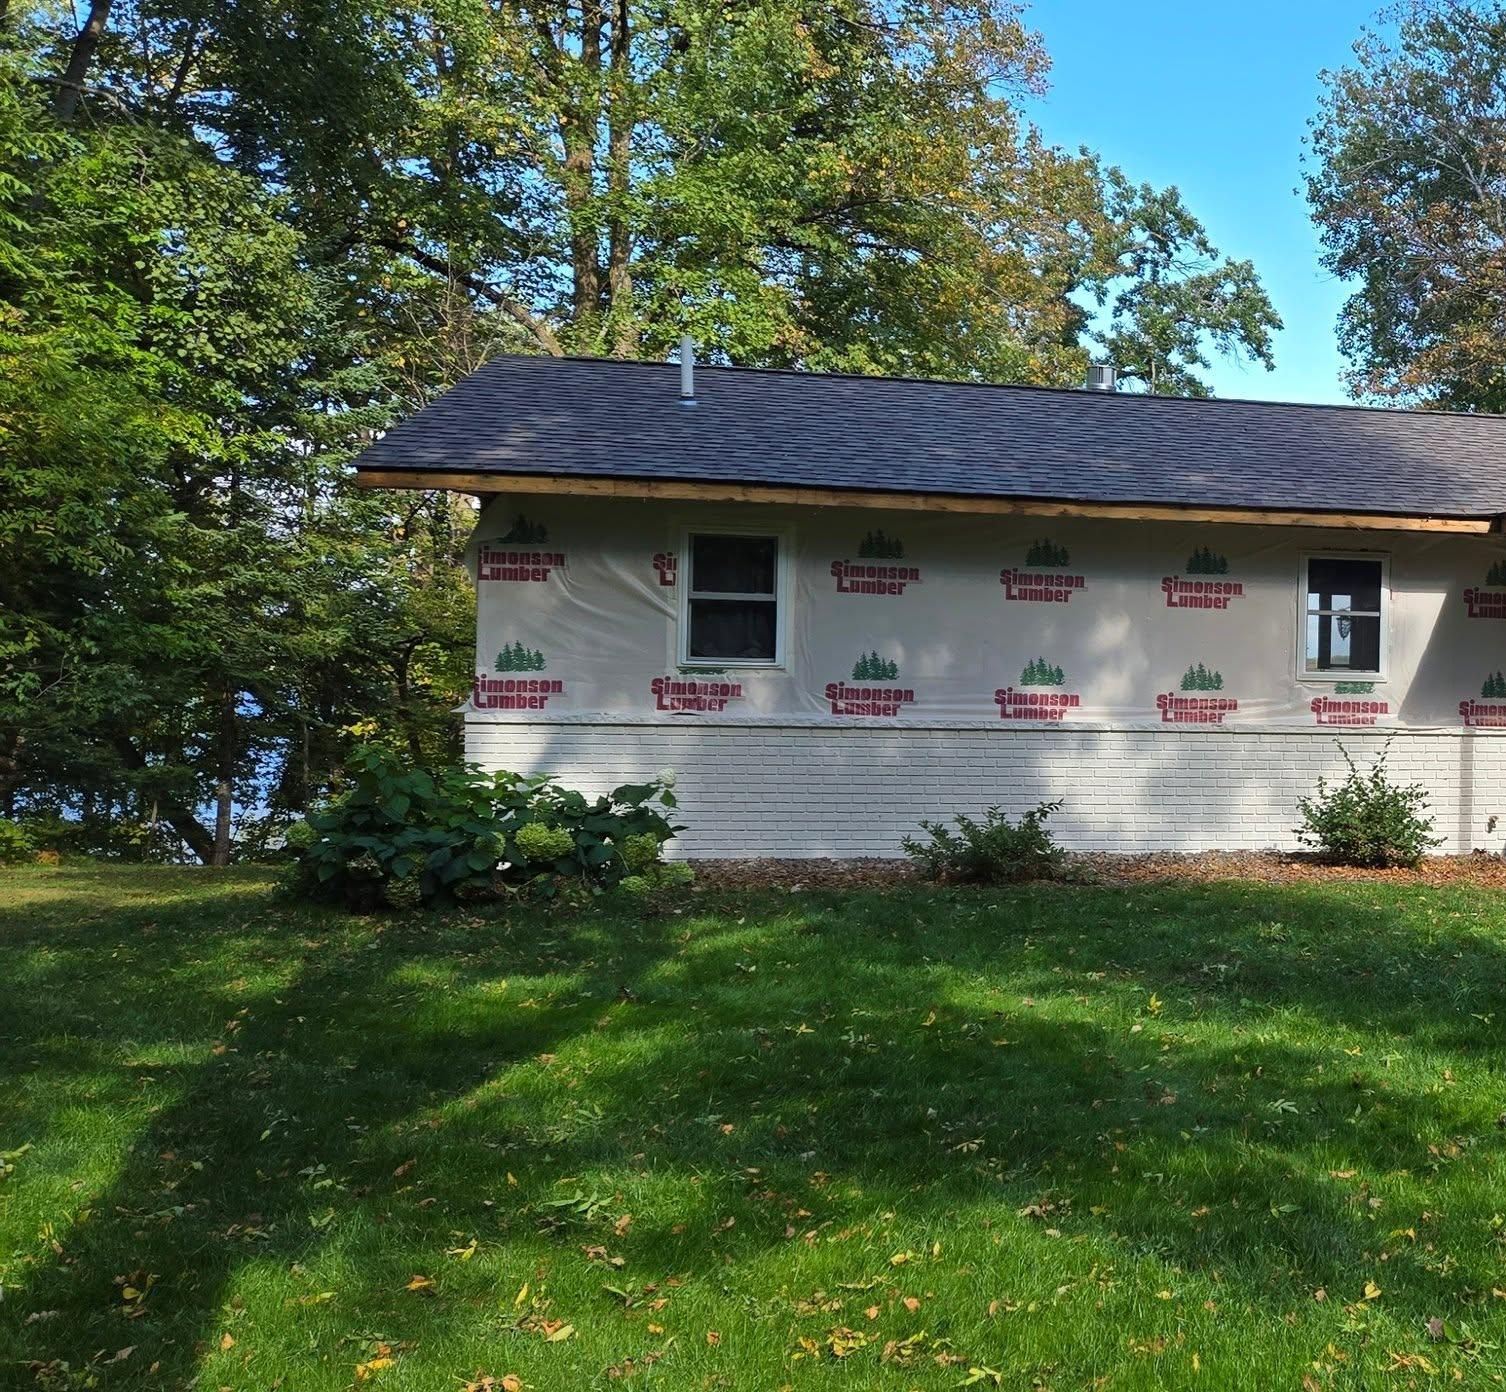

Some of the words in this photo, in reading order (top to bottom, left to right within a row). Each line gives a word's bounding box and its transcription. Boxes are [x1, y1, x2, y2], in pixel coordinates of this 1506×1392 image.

[831, 559, 920, 580] Simonson
[1000, 567, 1085, 588] Simonson
[837, 576, 906, 596] Lumber
[1005, 584, 1072, 602] Lumber
[1161, 575, 1243, 595] Simonson
[1167, 591, 1231, 609] Lumber
[651, 676, 741, 697] Simonson
[825, 680, 914, 702] Simonson
[474, 691, 548, 709] Lumber
[656, 693, 728, 711] Lumber
[994, 686, 1080, 707] Simonson
[1156, 692, 1238, 710] Simonson
[1311, 696, 1388, 714] Simonson
[832, 698, 900, 717] Lumber
[1000, 703, 1067, 720] Lumber
[1162, 707, 1225, 723] Lumber
[1317, 711, 1377, 725] Lumber
